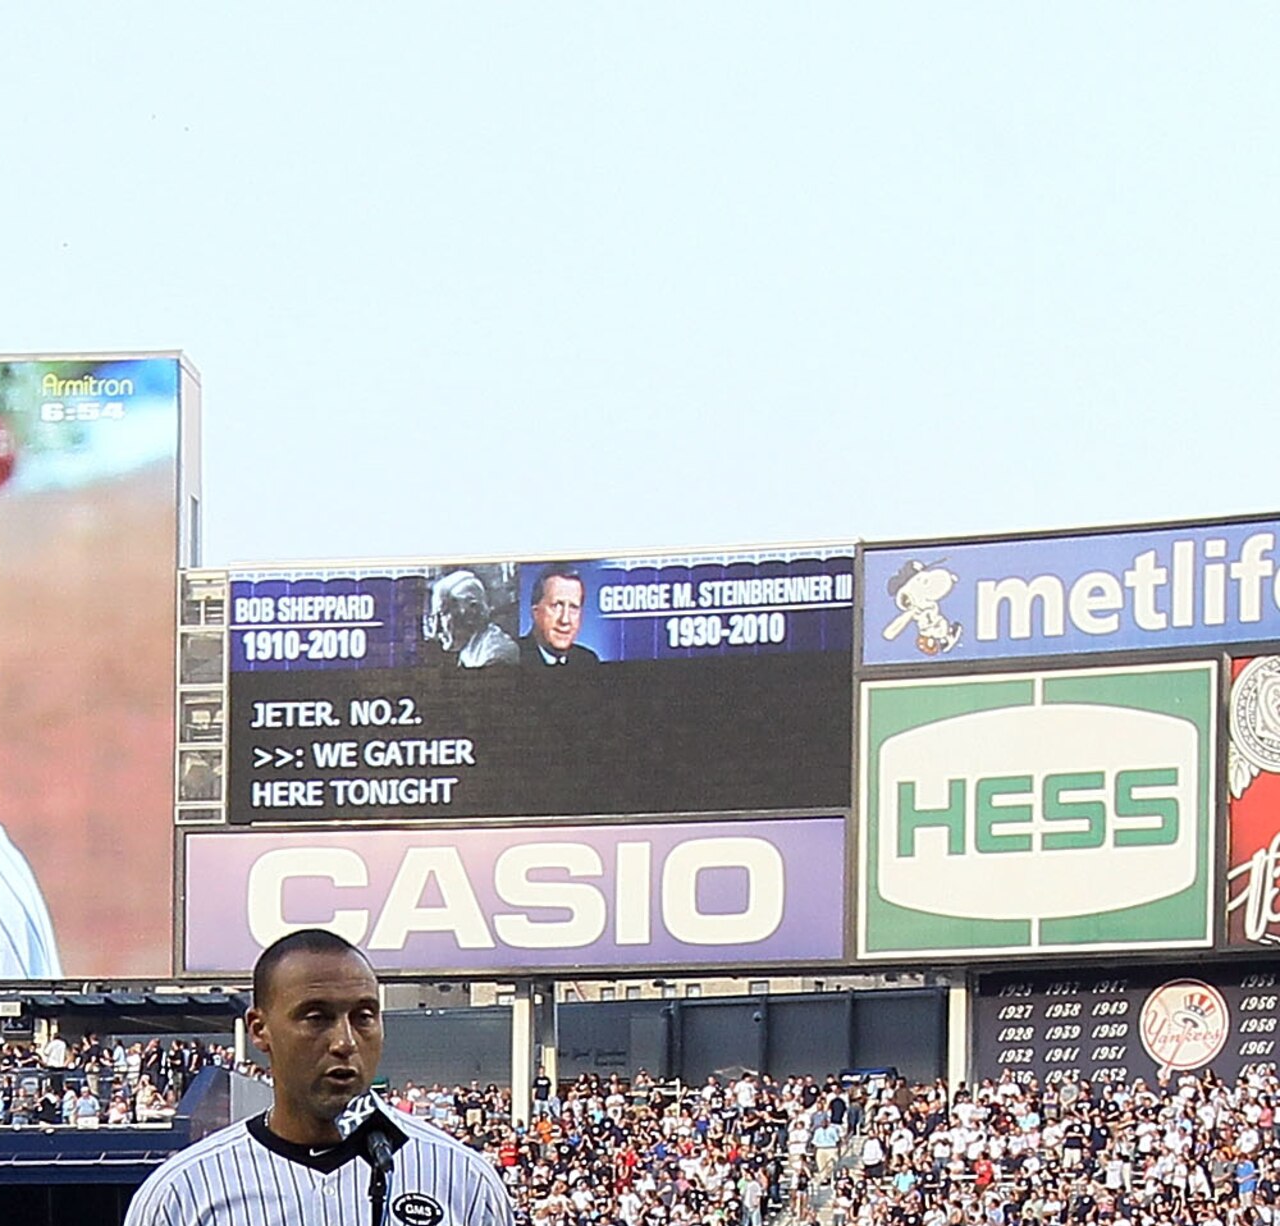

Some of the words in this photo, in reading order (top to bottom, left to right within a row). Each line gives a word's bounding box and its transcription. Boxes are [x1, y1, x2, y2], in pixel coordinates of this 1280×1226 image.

[42, 373, 133, 396] Armitron
[40, 402, 125, 422] 6:54
[599, 584, 670, 612] GEORGE
[673, 583, 695, 609] M.
[698, 575, 832, 608] STEINBRENNER
[835, 574, 852, 600] III
[977, 533, 1280, 641] metlif
[235, 597, 275, 623] BOB
[277, 595, 374, 622] SHEPPARD
[243, 629, 366, 660] 1910-2010
[666, 613, 785, 648] 1930-2010
[251, 702, 340, 728] JETER.
[350, 699, 422, 725] NO.2.
[312, 742, 358, 768] WE
[364, 739, 475, 767] GATHER
[252, 780, 324, 807] HERE
[329, 778, 459, 806] TONIGHT
[895, 767, 1180, 858] HESS
[247, 837, 783, 950] CASIO
[998, 1004, 1034, 1020] 1927
[1045, 1002, 1082, 1018] 1938
[1240, 995, 1277, 1010] 1956
[998, 1026, 1034, 1041] 1928
[1045, 1025, 1081, 1040] 1939
[1091, 1023, 1129, 1038] 1950
[1240, 1018, 1277, 1032] 1958
[998, 1048, 1034, 1064] 1932
[1091, 1046, 1127, 1060] 1951
[1239, 1041, 1275, 1055] 1961
